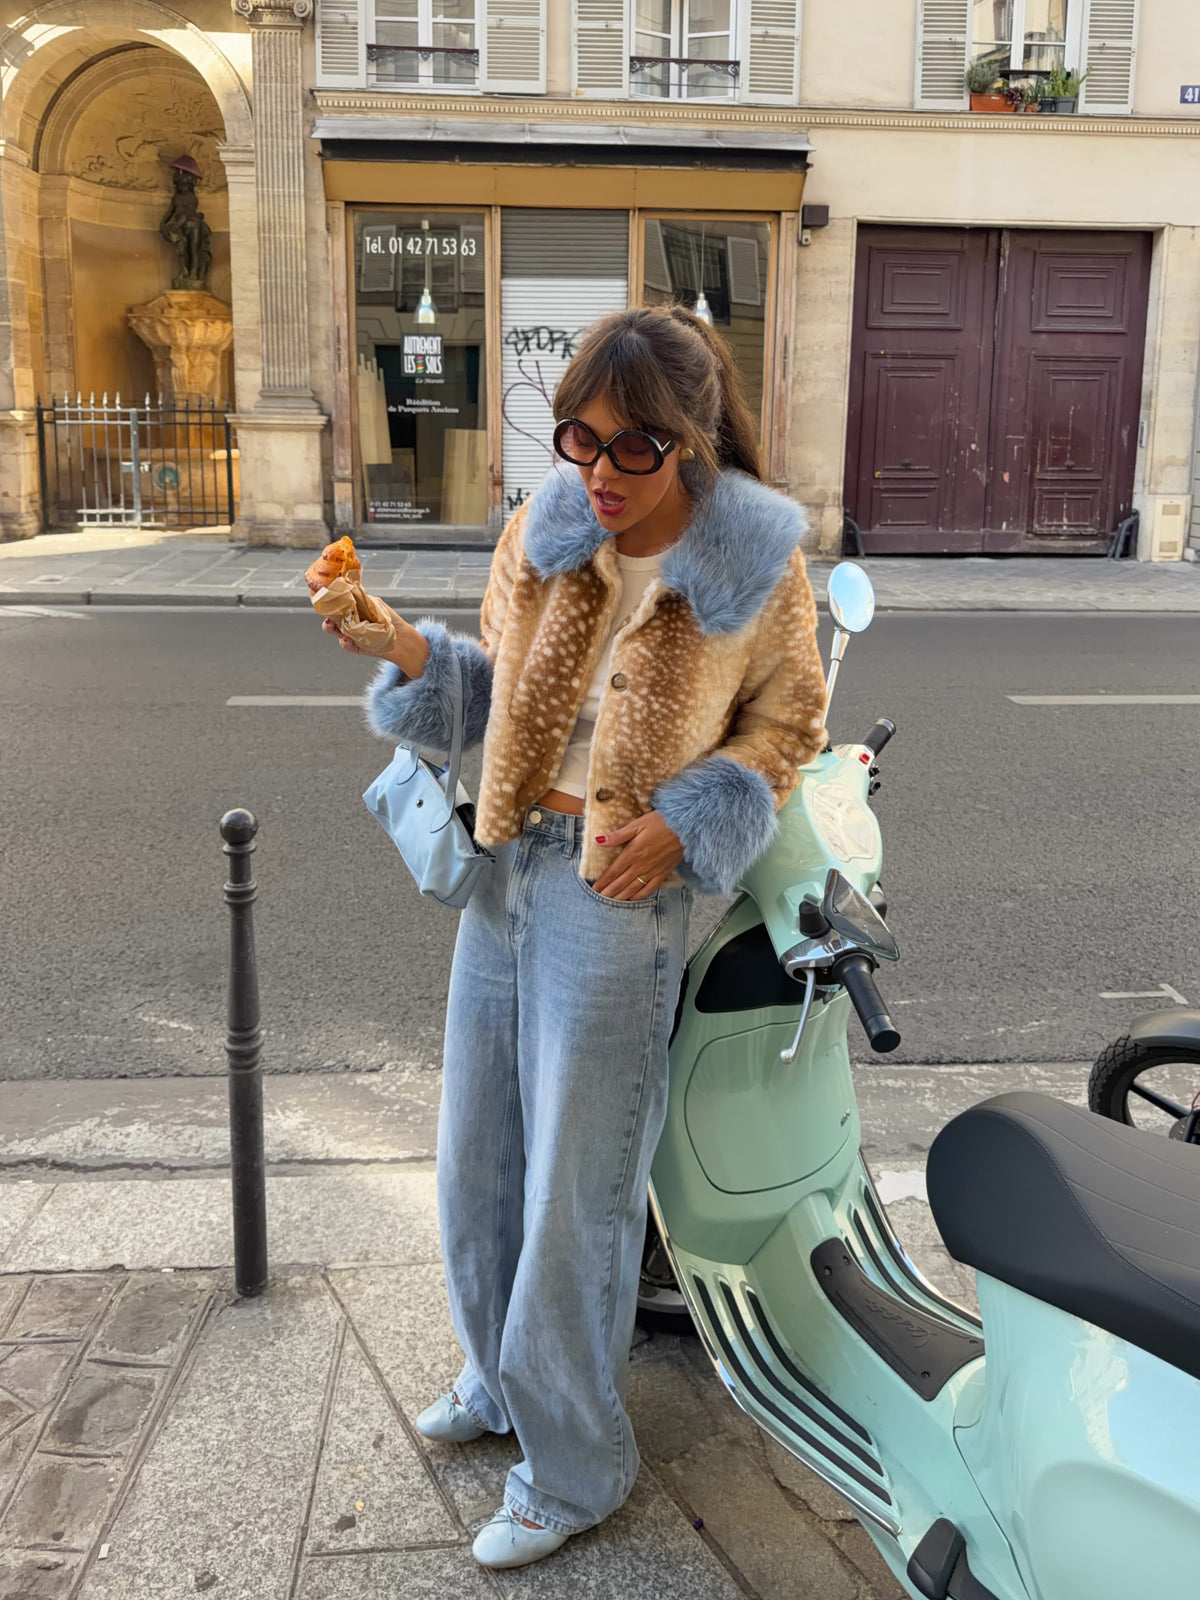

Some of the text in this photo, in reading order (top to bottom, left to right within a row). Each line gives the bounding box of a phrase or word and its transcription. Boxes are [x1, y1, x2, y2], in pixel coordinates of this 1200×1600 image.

[1184, 87, 1199, 102] 41
[365, 235, 476, 256] Tél. 01 42 71 53 63
[404, 336, 442, 354] AUTREMENT
[404, 355, 442, 374] LES SOLS
[398, 405, 430, 414] Parquets
